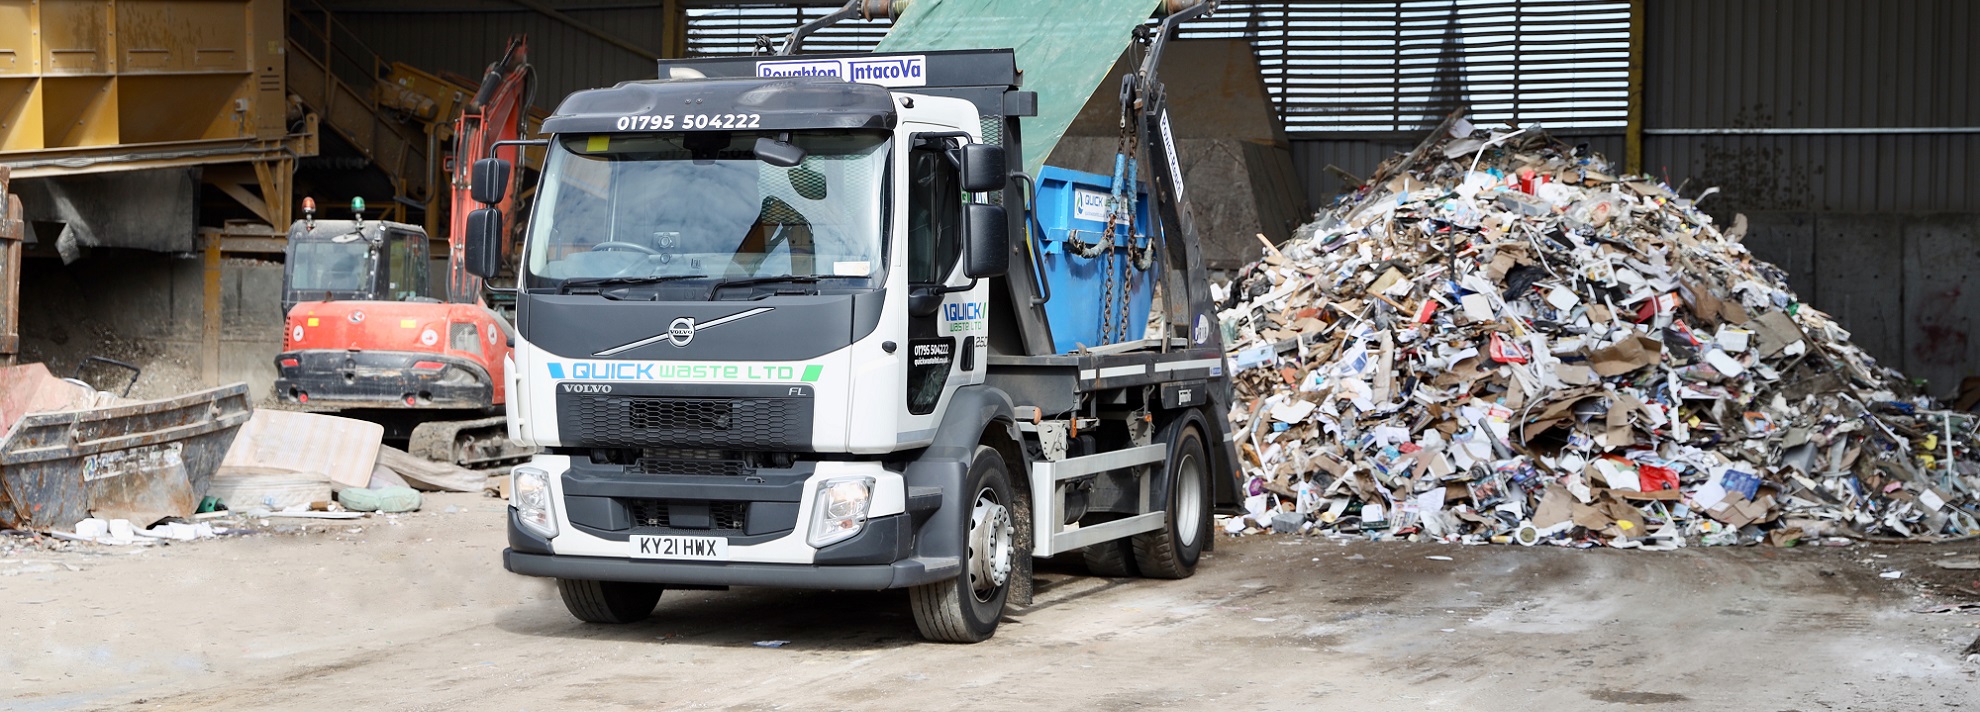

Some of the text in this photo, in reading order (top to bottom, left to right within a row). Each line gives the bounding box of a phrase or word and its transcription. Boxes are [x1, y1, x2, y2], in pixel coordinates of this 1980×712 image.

[848, 59, 921, 83] IntacoVa
[617, 114, 761, 130] 01795 504222
[949, 302, 982, 321] QUICK
[914, 344, 949, 356] 01795 504222
[572, 362, 655, 380] QUICK
[747, 365, 794, 379] LTD
[562, 383, 613, 394] VOLVO
[788, 386, 807, 396] FL
[640, 537, 717, 557] KY21 HWX
